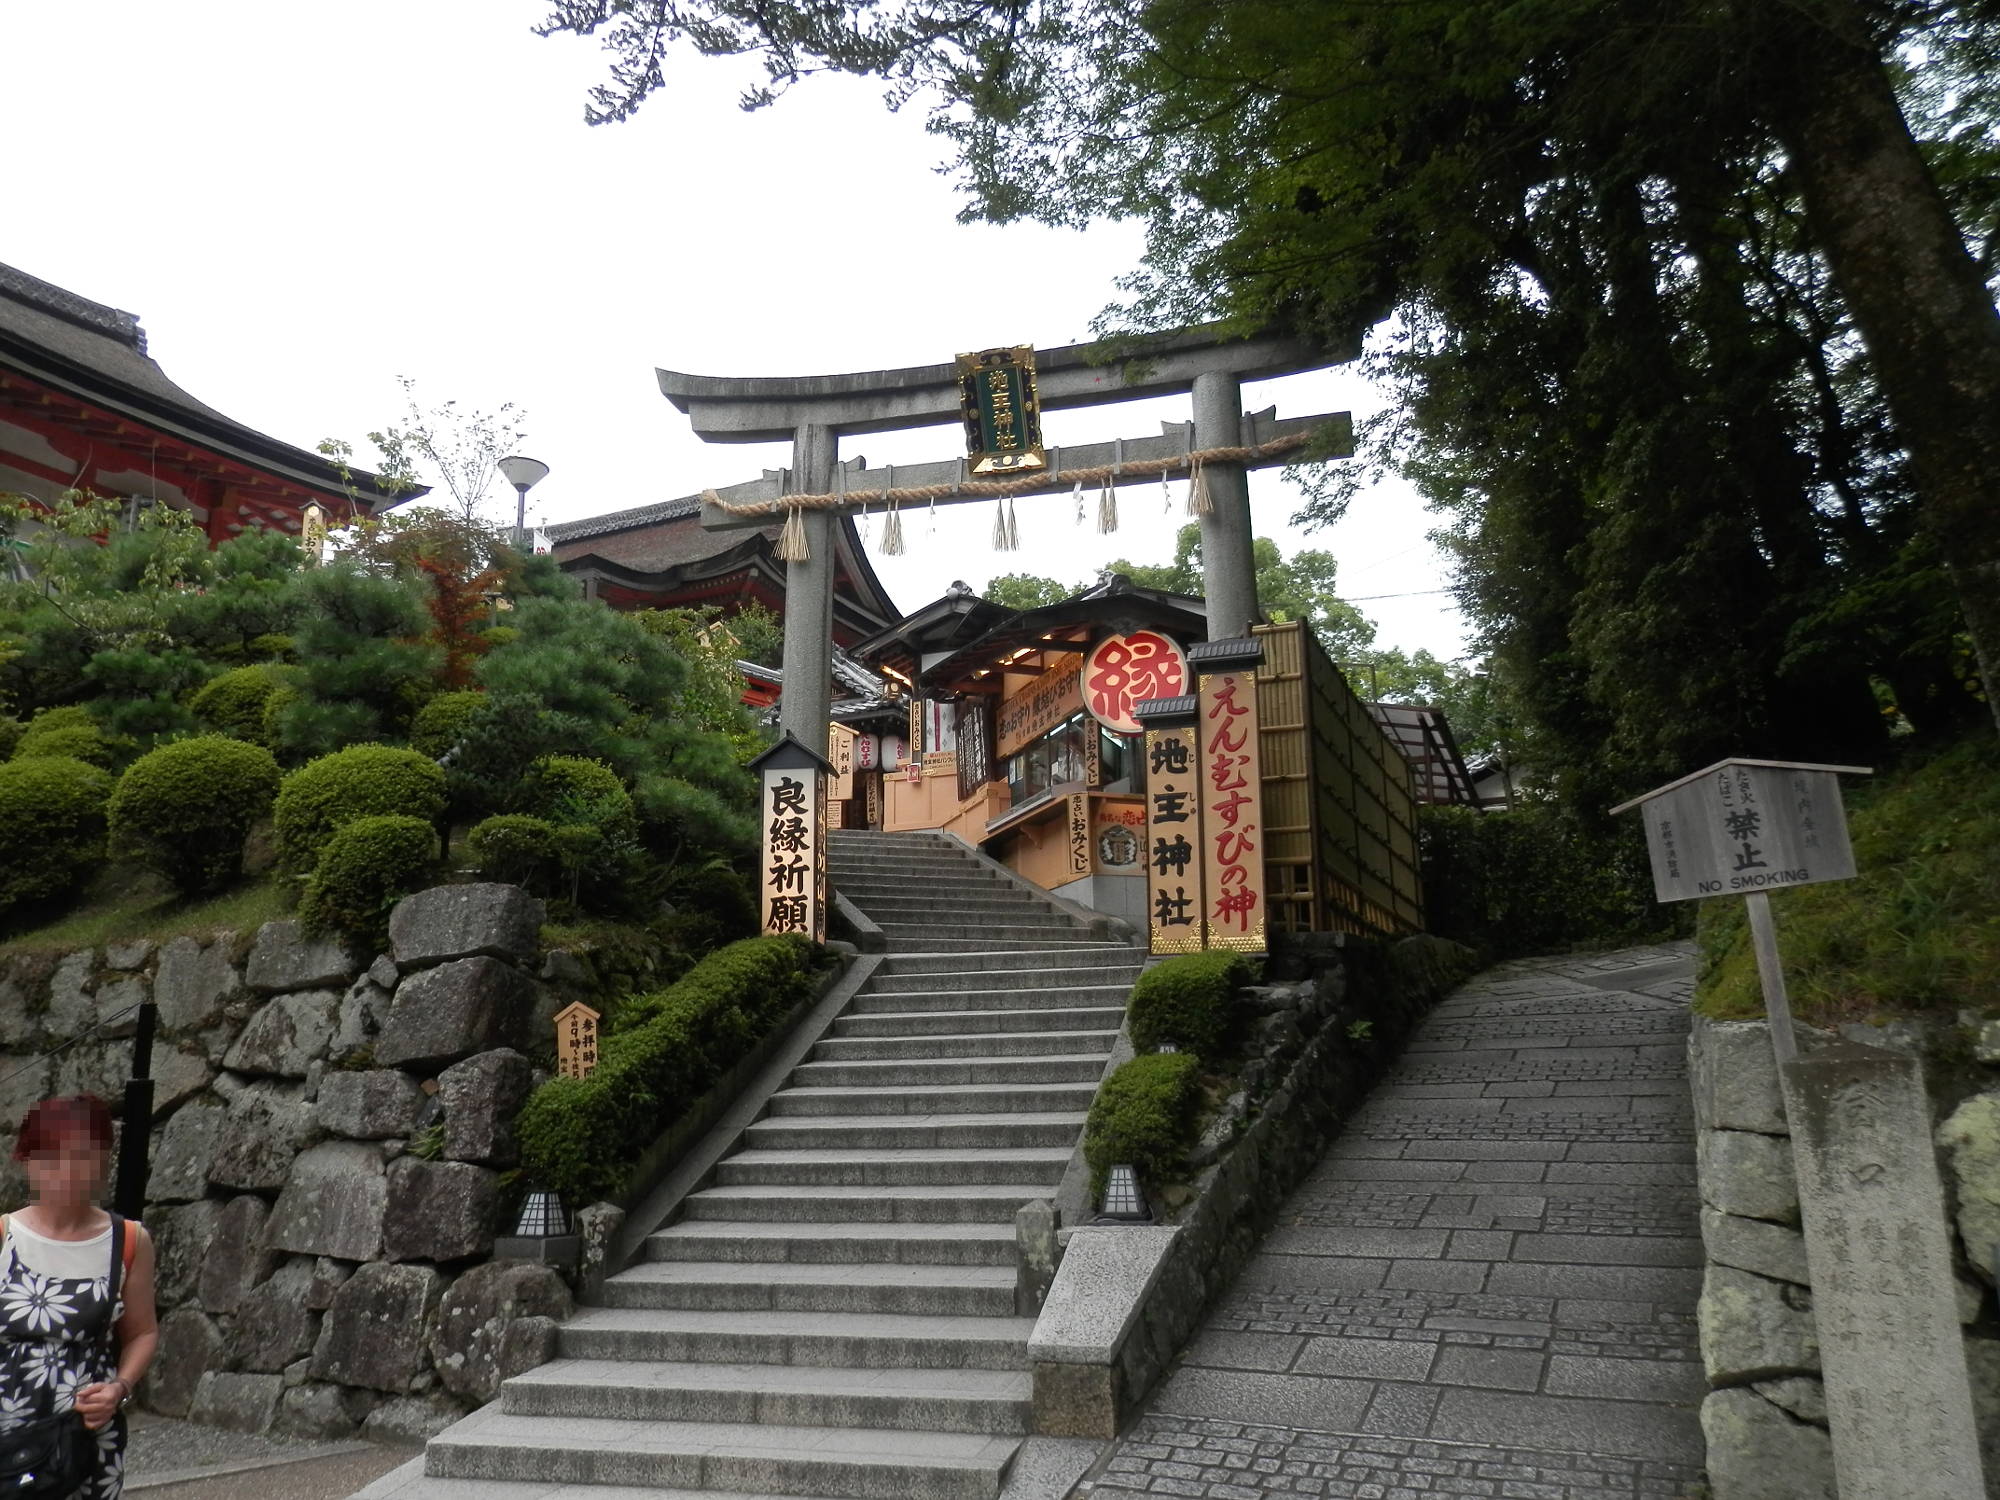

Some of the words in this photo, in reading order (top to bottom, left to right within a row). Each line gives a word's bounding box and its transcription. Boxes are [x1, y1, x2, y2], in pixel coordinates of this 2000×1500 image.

[988, 370, 1018, 450] 地主神社
[1089, 633, 1182, 726] 縁
[1072, 795, 1089, 872] 恋占いおみくじ
[1149, 737, 1195, 928] 地主神社
[1208, 676, 1258, 932] えんむすびの神
[1724, 807, 1768, 873] 禁止
[766, 776, 811, 934] 良縁祈願
[1698, 877, 1723, 894] NO
[1730, 868, 1810, 890] SMOKING
